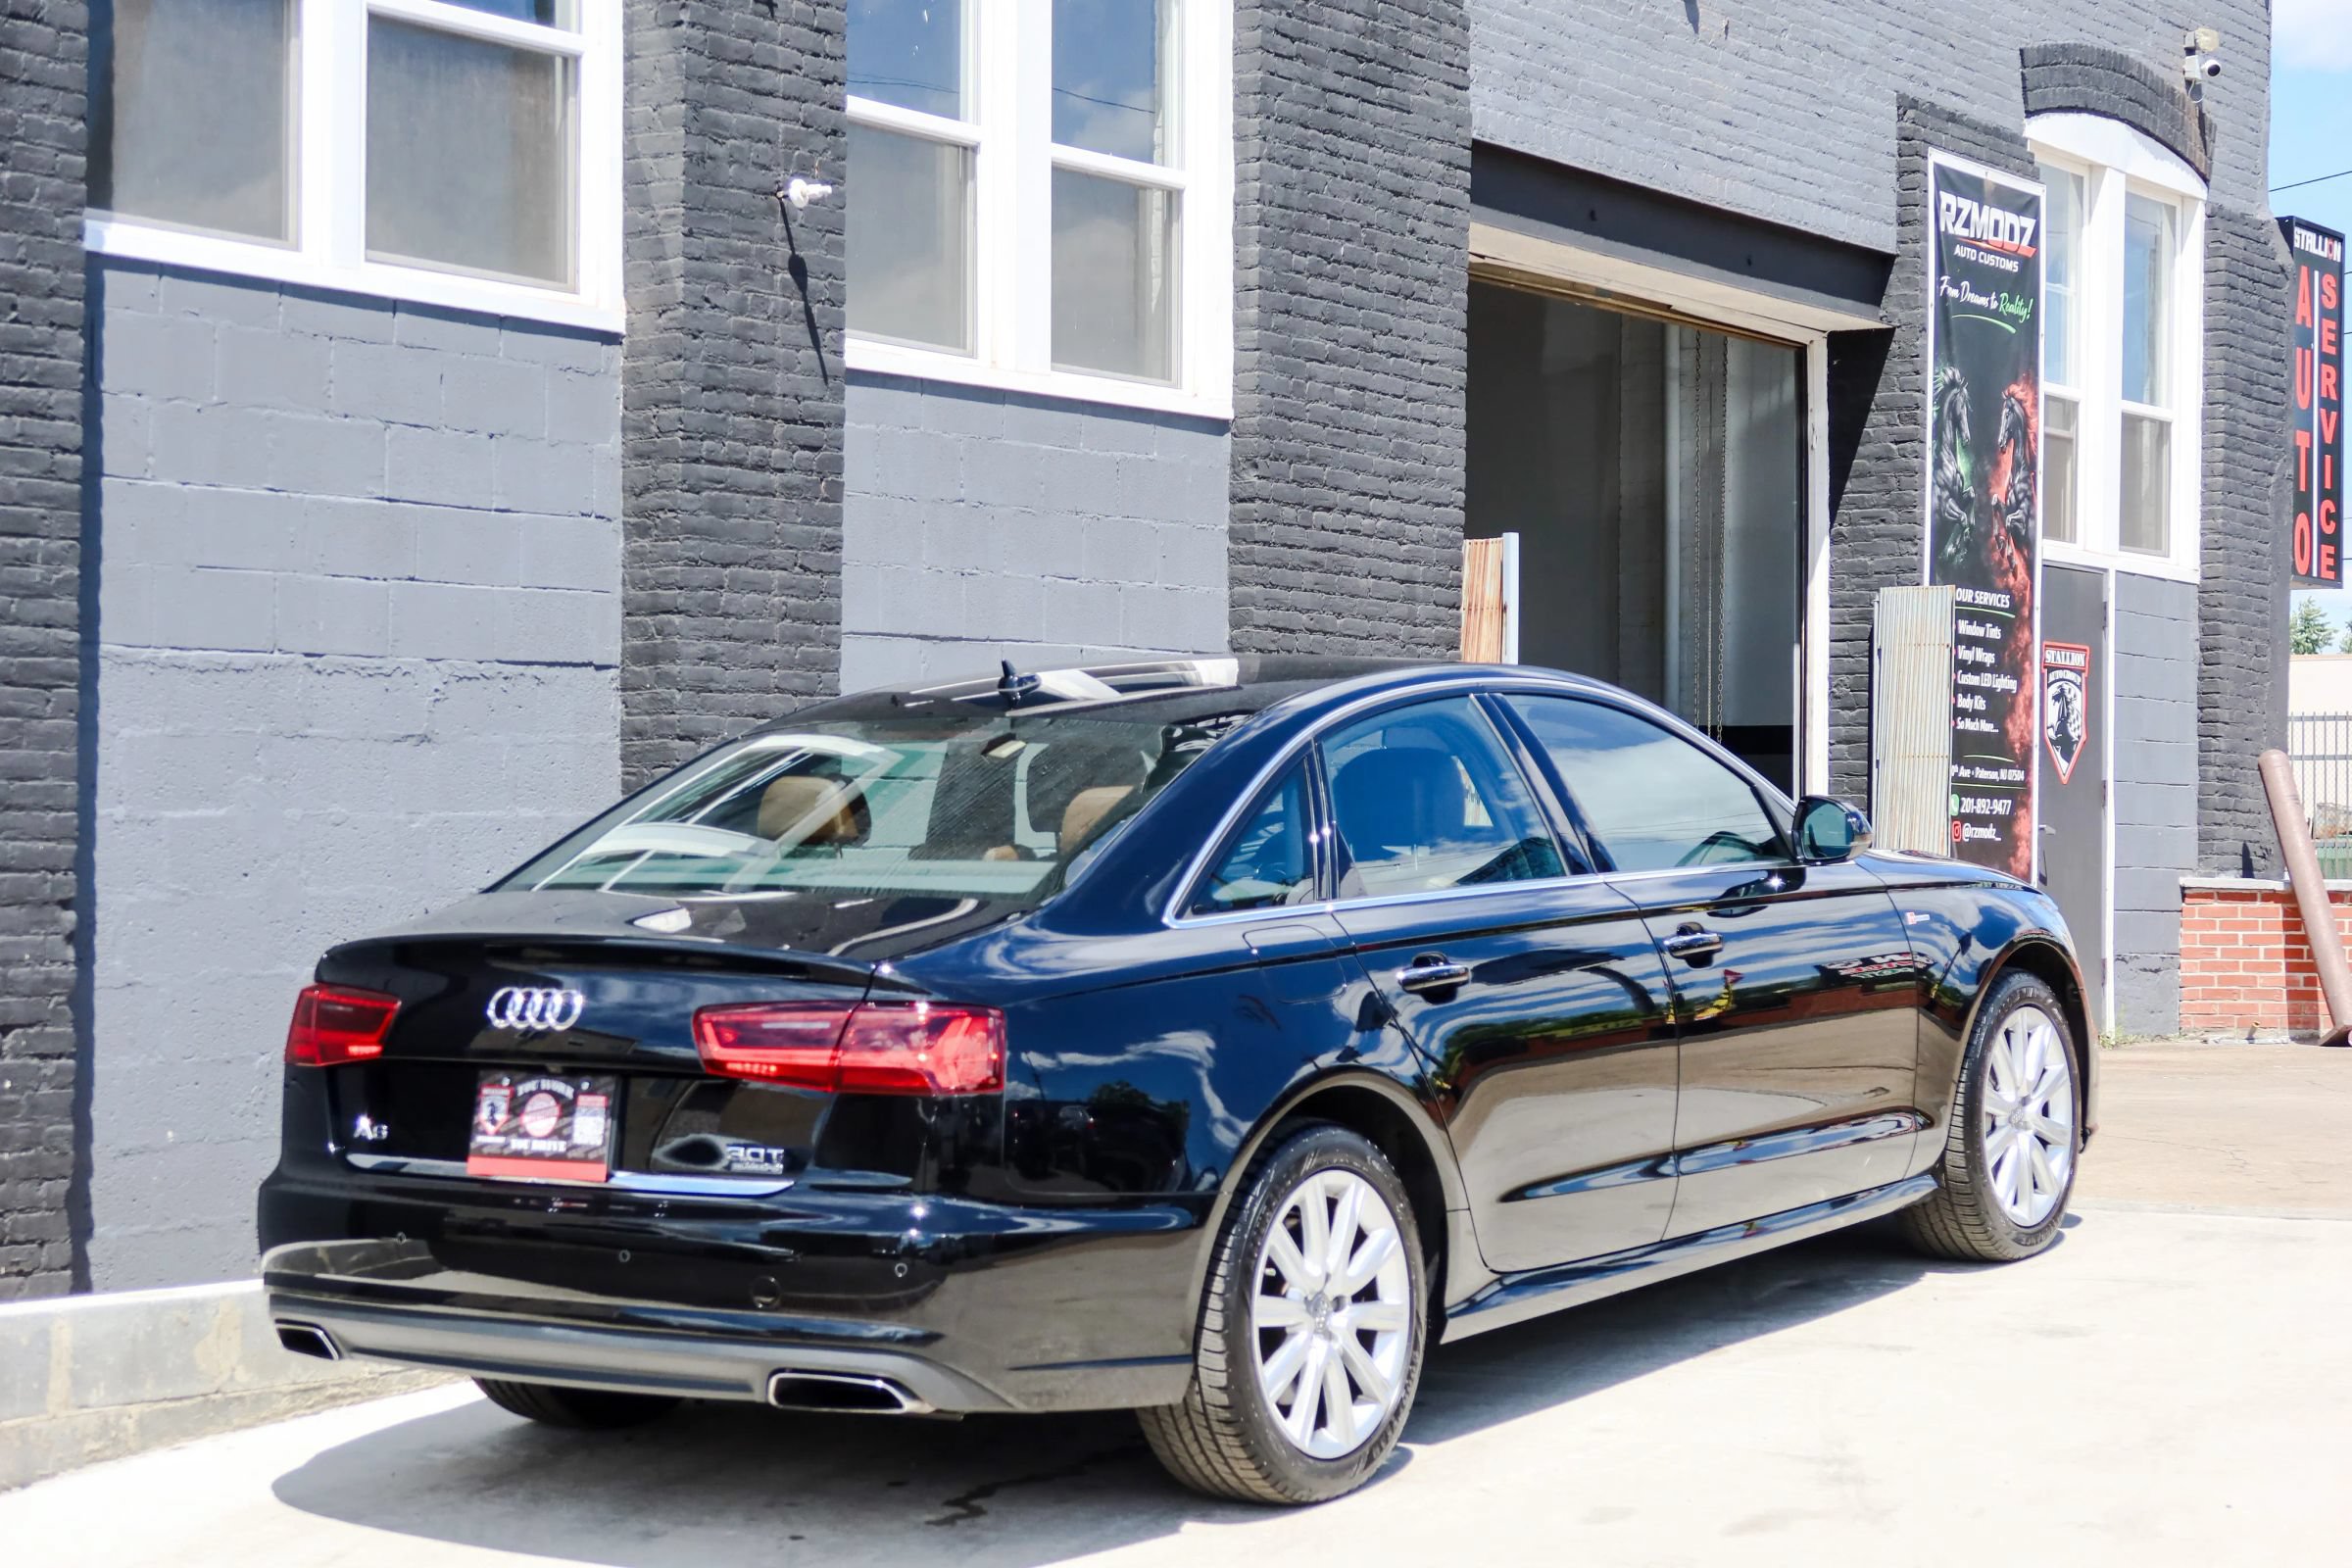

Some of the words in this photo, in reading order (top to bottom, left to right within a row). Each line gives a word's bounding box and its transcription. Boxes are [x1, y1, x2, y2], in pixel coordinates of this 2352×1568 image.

[1939, 191, 2038, 258] RZMODZ
[2294, 225, 2341, 263] STALLION
[1953, 245, 1977, 261] AUTO
[1979, 250, 2019, 272] CUSTOMS
[1940, 275, 1960, 298] From
[1960, 280, 1989, 308] Dreams
[1989, 291, 1999, 310] to
[1999, 292, 2034, 323] Reality!
[2295, 265, 2313, 576] AUTO
[2319, 271, 2338, 580] SERVICE
[1956, 588, 1974, 604] OUR
[1974, 590, 2010, 608] SERVICES
[1958, 619, 1985, 637] Window
[1985, 623, 2001, 639] Tints
[1958, 645, 1975, 664] Vinyl
[1975, 647, 1995, 666] Wraps
[2045, 649, 2085, 666] STALLION
[1957, 669, 1980, 686] Custom
[1981, 672, 1991, 687] LED
[1991, 674, 2017, 693] Lighting
[1957, 693, 1974, 712] Body
[1974, 695, 1985, 710] Kits
[1956, 716, 1964, 730] So
[1964, 717, 1980, 731] Much
[1959, 765, 1971, 778] Ave
[1999, 768, 2007, 780] NJ
[1960, 797, 2012, 815] 201-892-9477
[353, 1114, 388, 1140] A6
